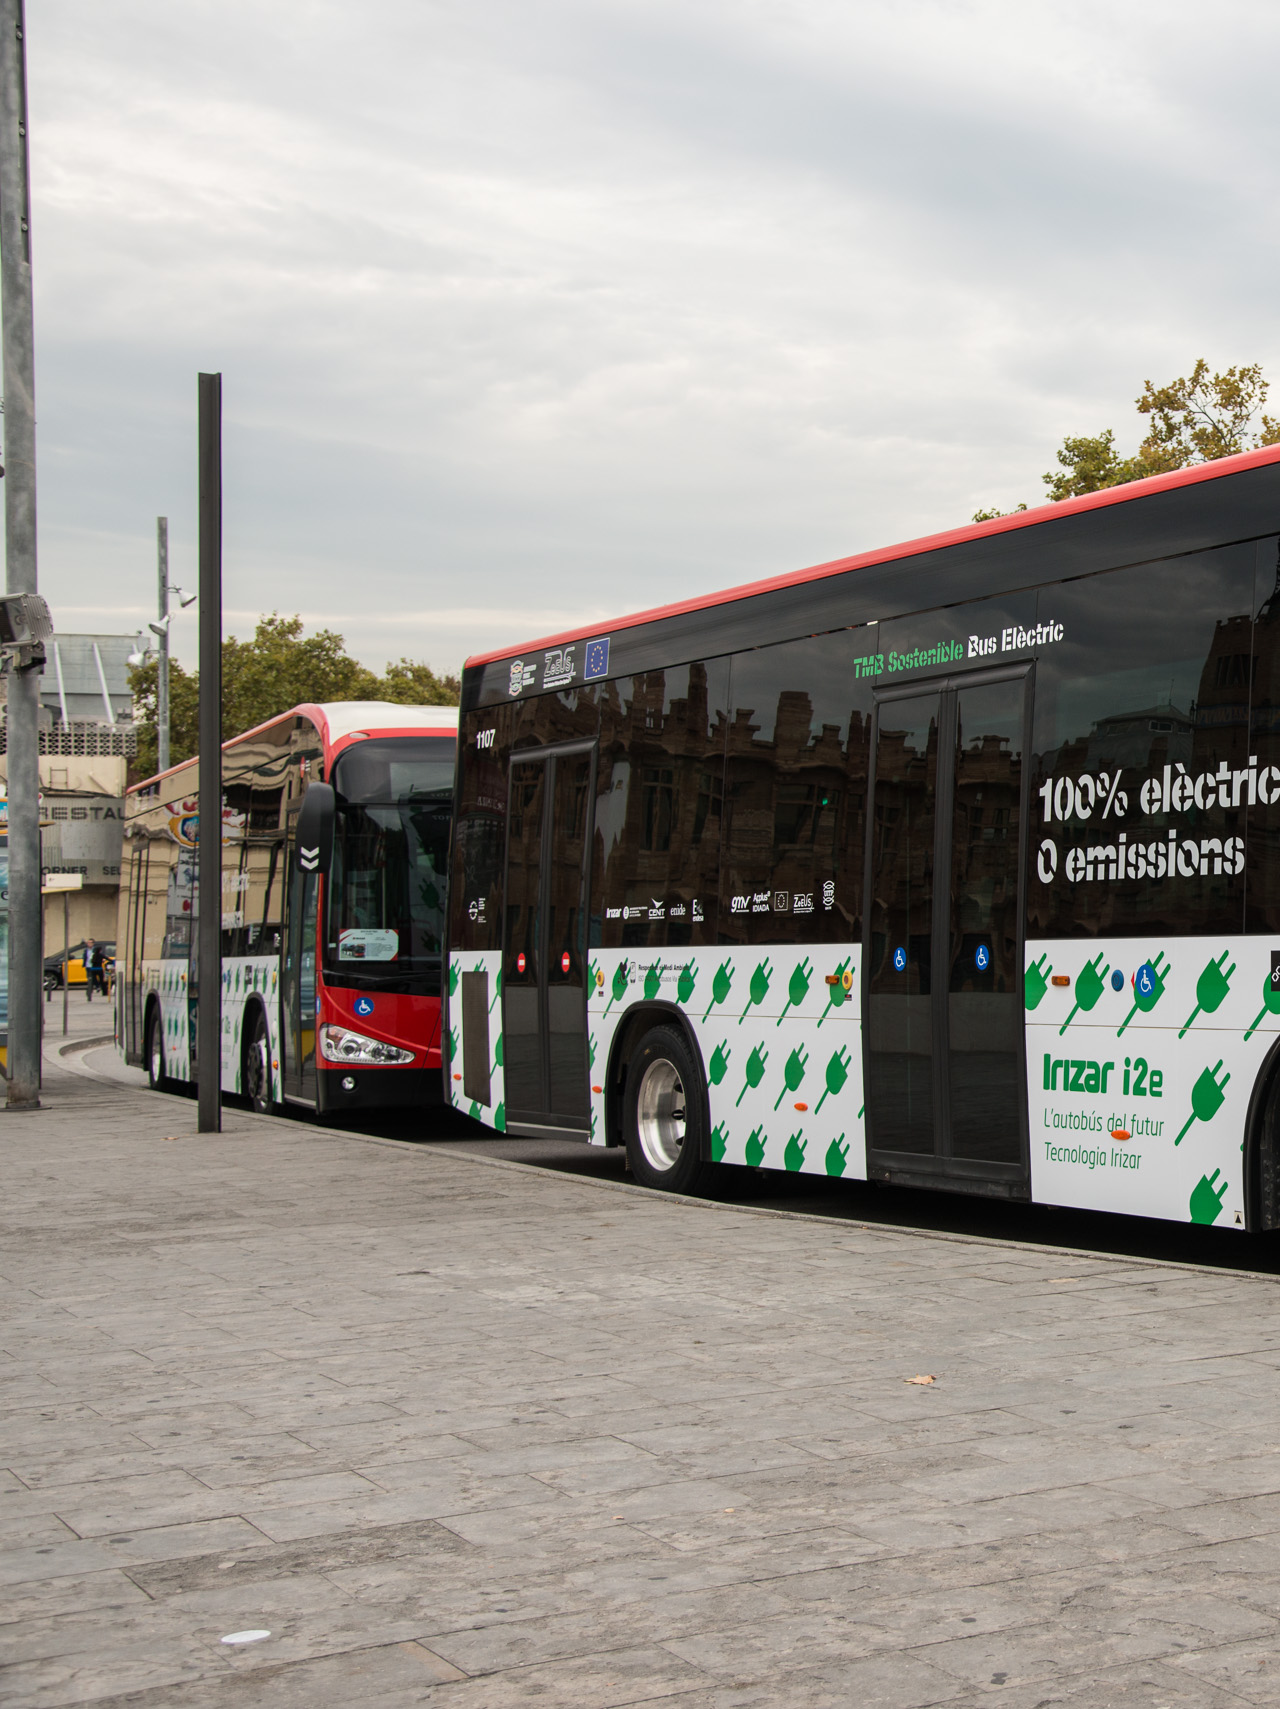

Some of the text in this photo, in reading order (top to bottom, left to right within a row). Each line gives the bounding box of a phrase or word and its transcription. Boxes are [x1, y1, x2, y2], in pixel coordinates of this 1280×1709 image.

[853, 619, 1064, 678] TMB Sostenible Bus Elèctric
[476, 728, 496, 750] 1107
[1039, 769, 1129, 823] 100%
[1037, 828, 1246, 884] 0 emissions
[1043, 1053, 1163, 1098] Irizar i2e
[1043, 1107, 1165, 1139] L'autobús del futur
[1044, 1141, 1142, 1170] Tecnologia Irizar
